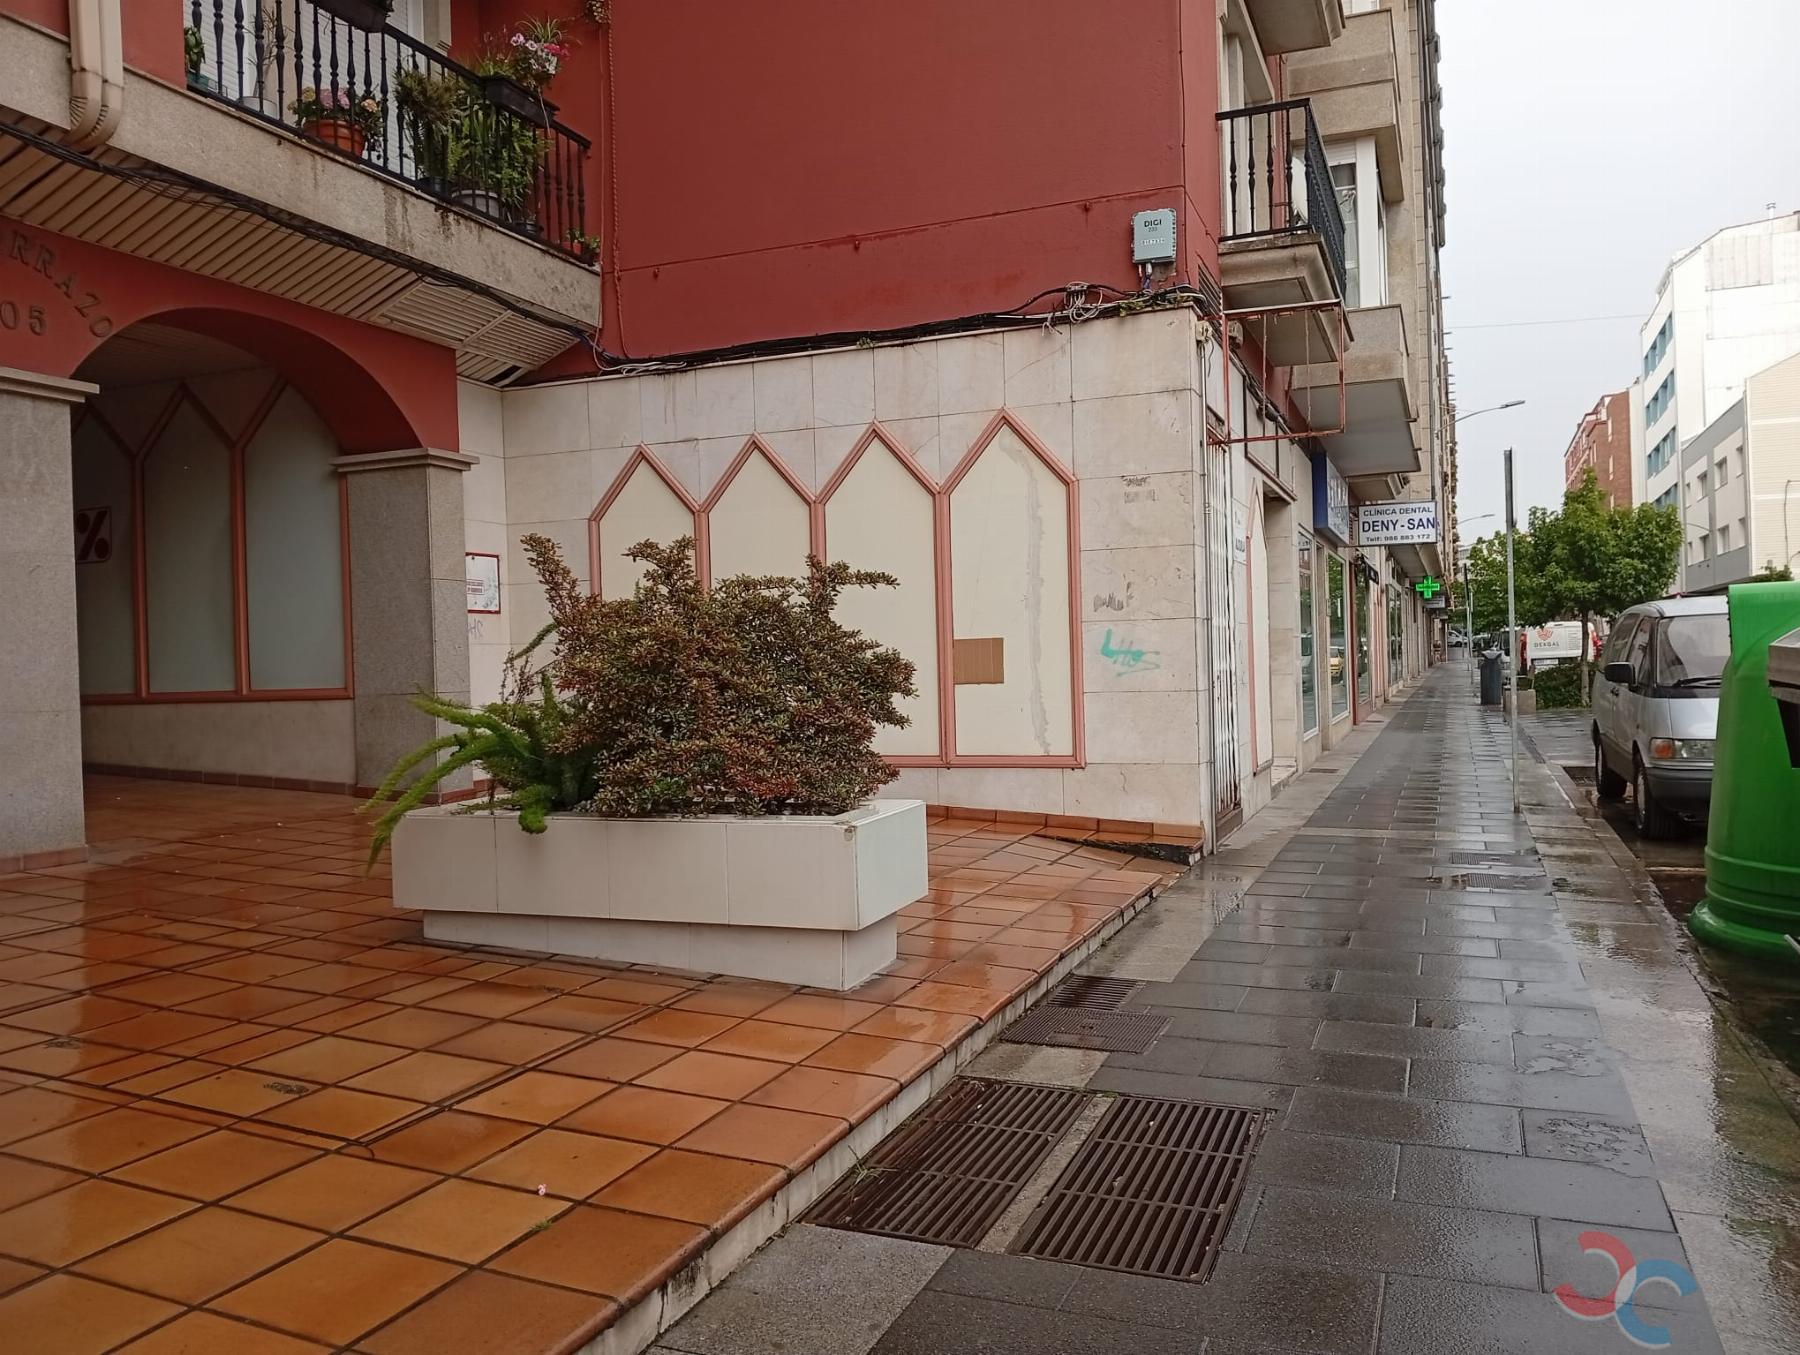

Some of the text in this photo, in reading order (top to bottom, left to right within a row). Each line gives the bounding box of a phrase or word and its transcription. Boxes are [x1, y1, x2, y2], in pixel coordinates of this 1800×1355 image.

[1144, 219, 1162, 227] DIGI
[1399, 506, 1433, 515] DENTAL
[1362, 519, 1399, 533] DENY
[1407, 517, 1435, 530] SAN
